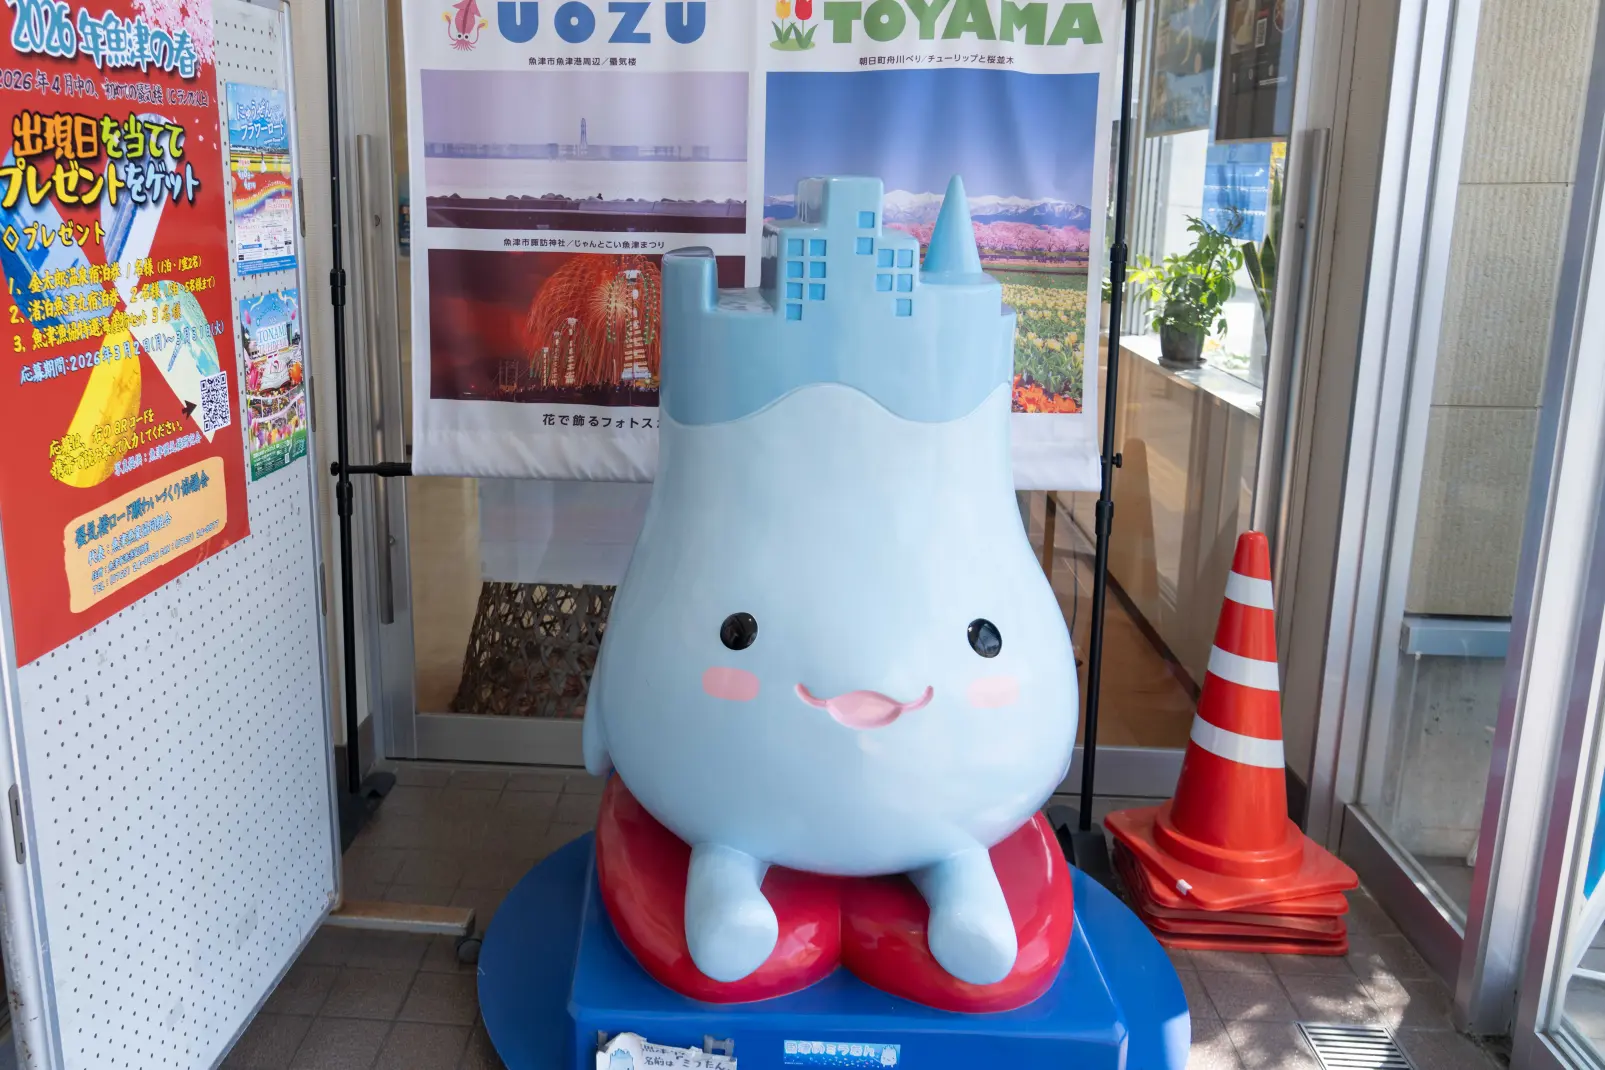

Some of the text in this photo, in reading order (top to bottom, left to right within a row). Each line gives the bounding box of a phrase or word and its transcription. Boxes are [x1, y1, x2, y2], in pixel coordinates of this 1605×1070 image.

[498, 1, 706, 45] UOZU
[824, 0, 1103, 46] TOYAMA
[12, 108, 186, 160] 出現日を当てて
[0, 160, 201, 208] プレゼントをゲット
[24, 220, 105, 251] プレゼント
[542, 413, 660, 429] 花で飾るフォトス
